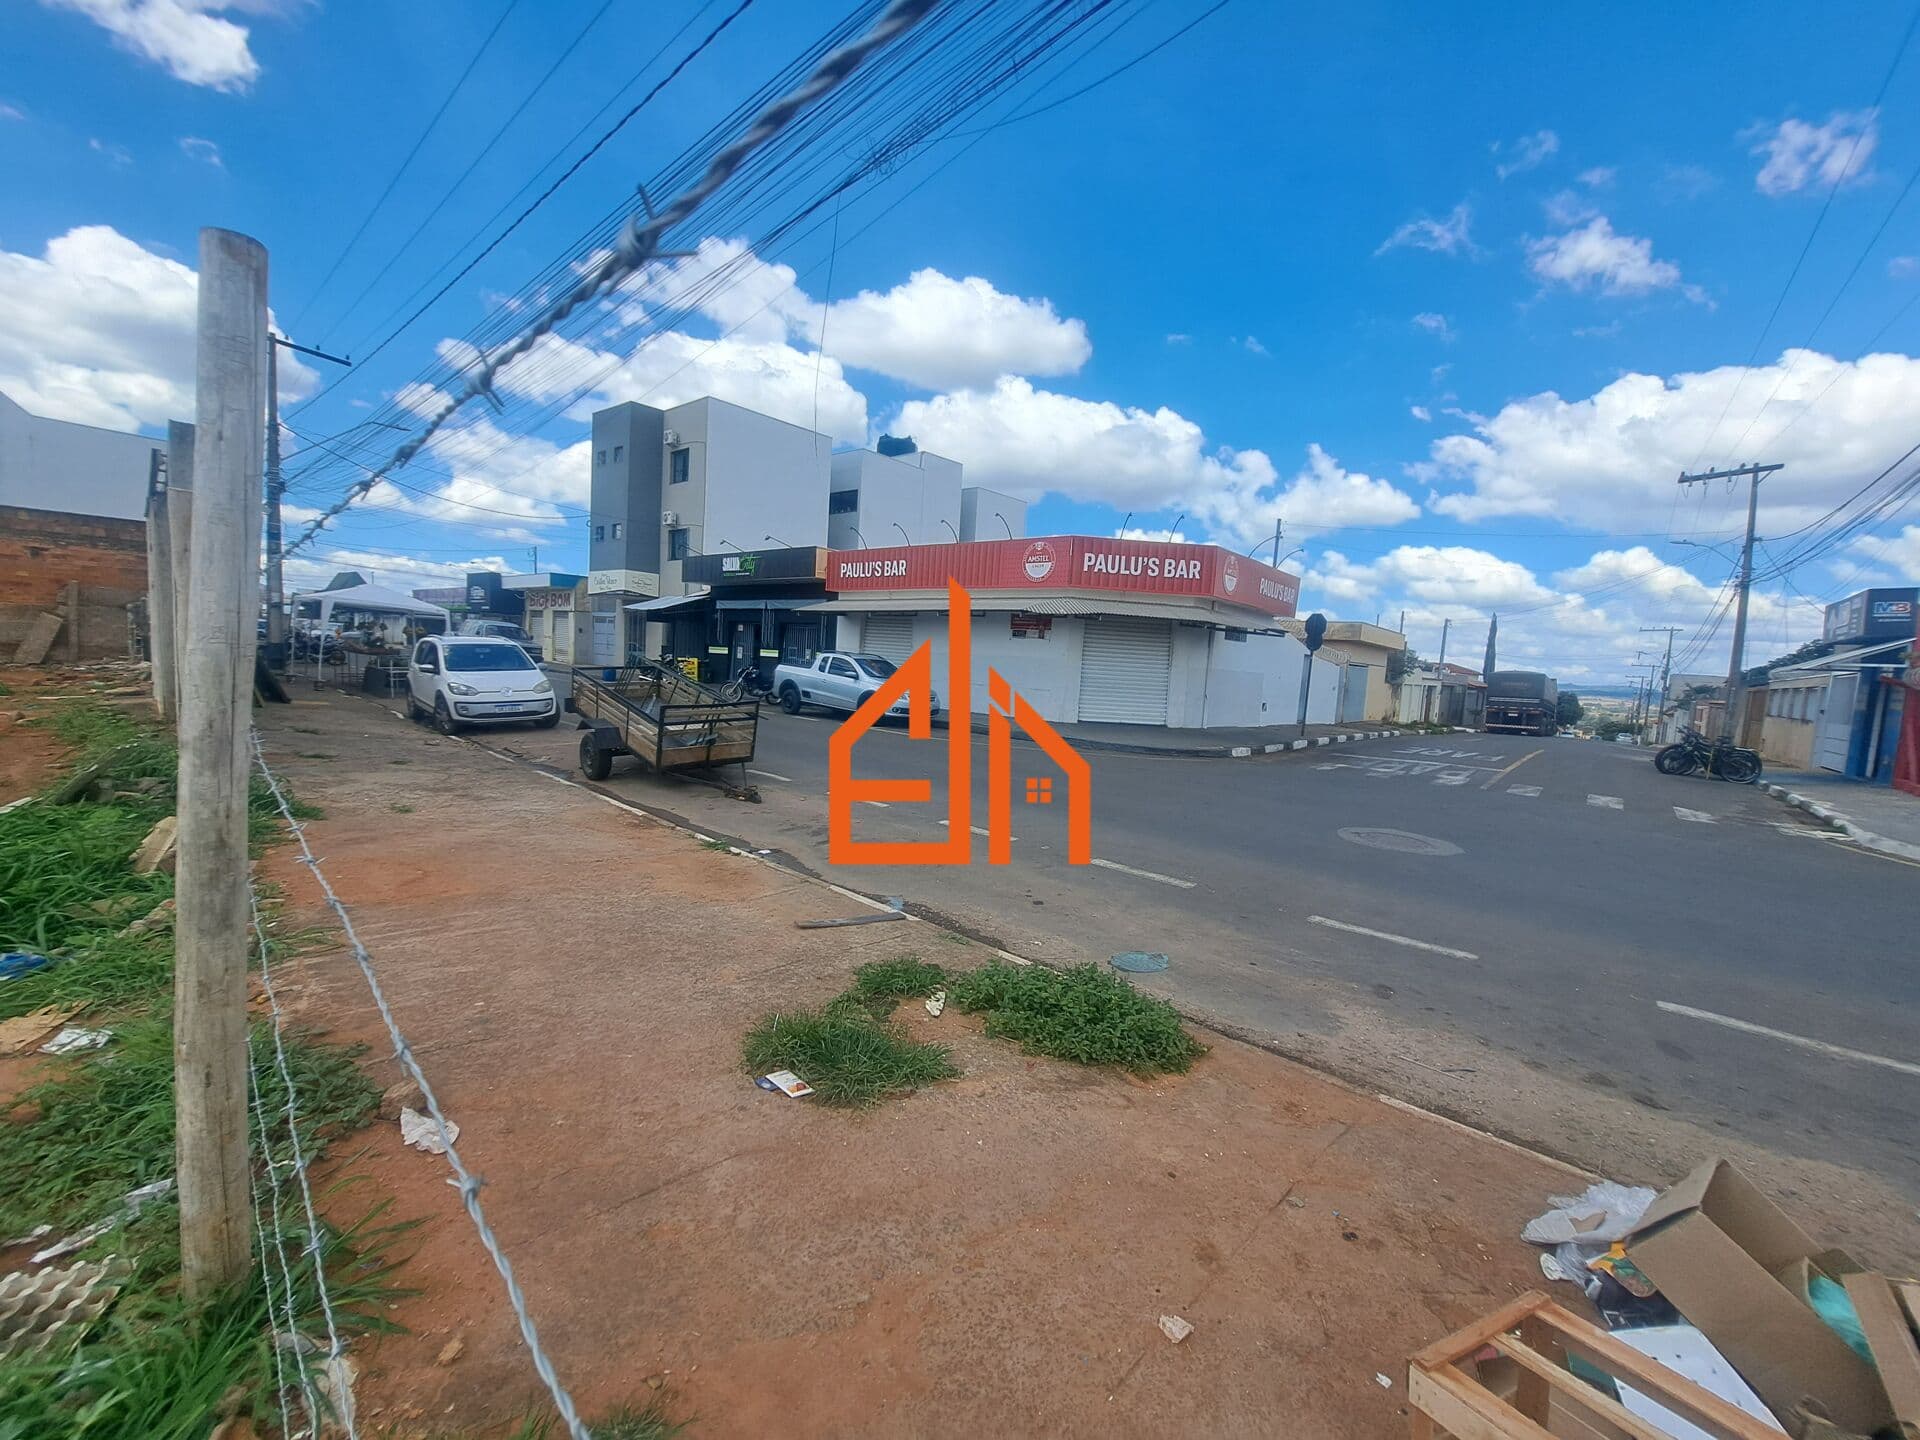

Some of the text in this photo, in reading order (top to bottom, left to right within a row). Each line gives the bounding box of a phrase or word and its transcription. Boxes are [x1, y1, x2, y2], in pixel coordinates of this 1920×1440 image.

[840, 559, 907, 578] PAULU'S BAR
[1083, 552, 1201, 579] PAULU'S BAR
